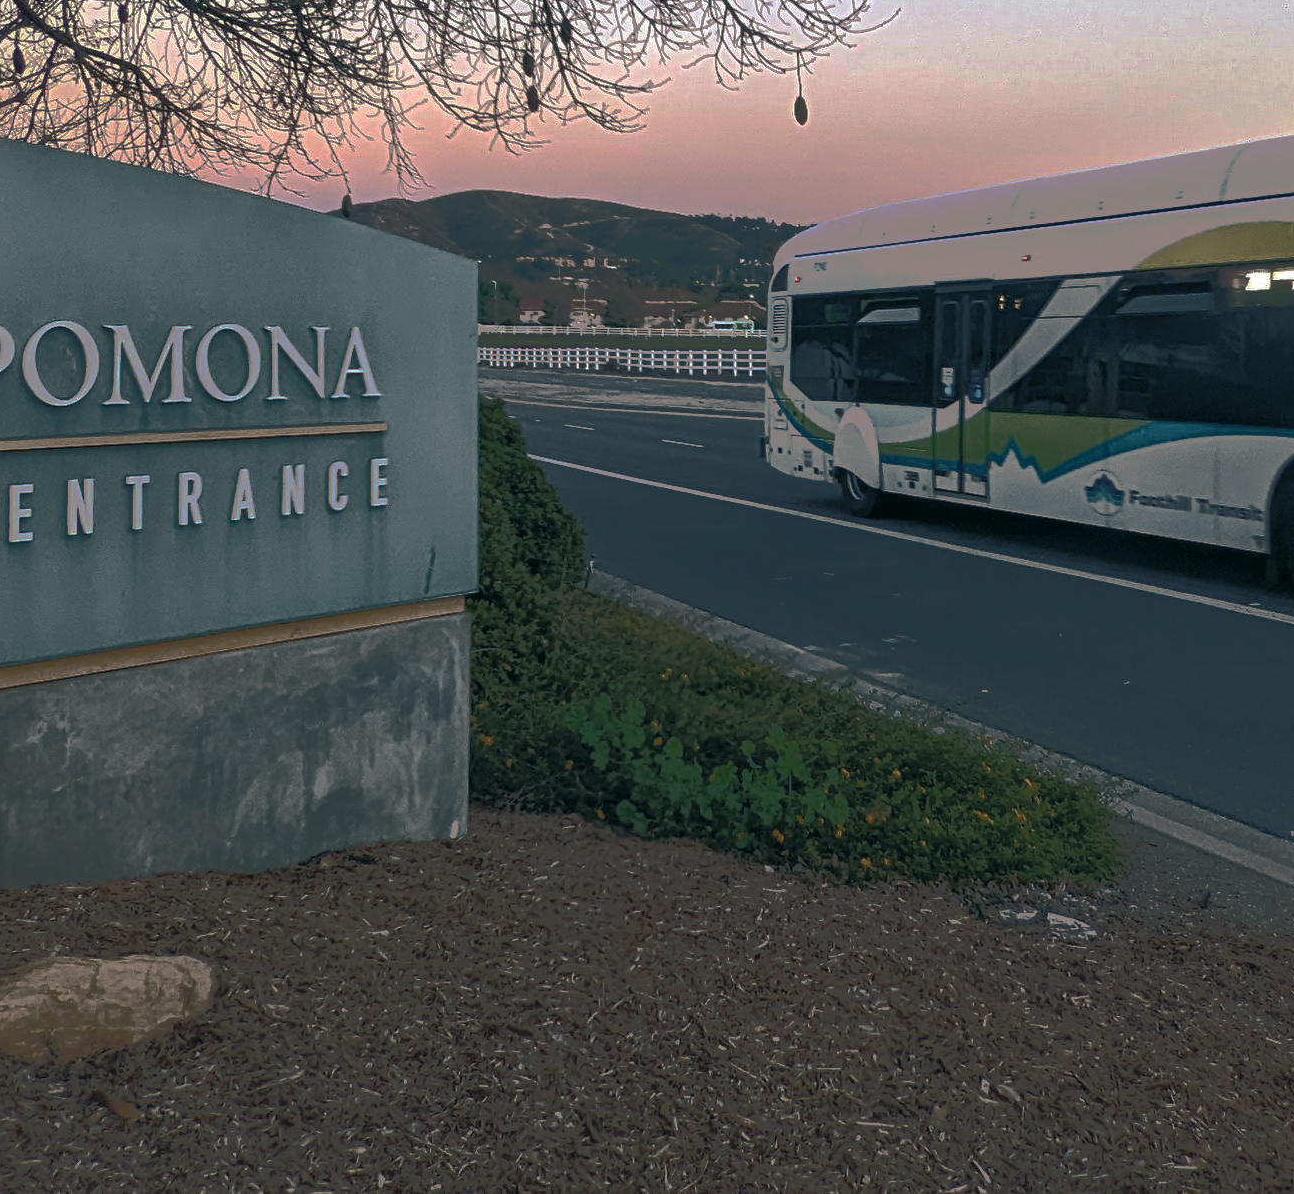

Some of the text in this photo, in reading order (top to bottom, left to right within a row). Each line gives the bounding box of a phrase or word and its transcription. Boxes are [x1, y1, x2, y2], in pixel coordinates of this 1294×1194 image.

[8, 457, 390, 543] ENTRANCE
[1129, 489, 1265, 523] Foothill Transit
